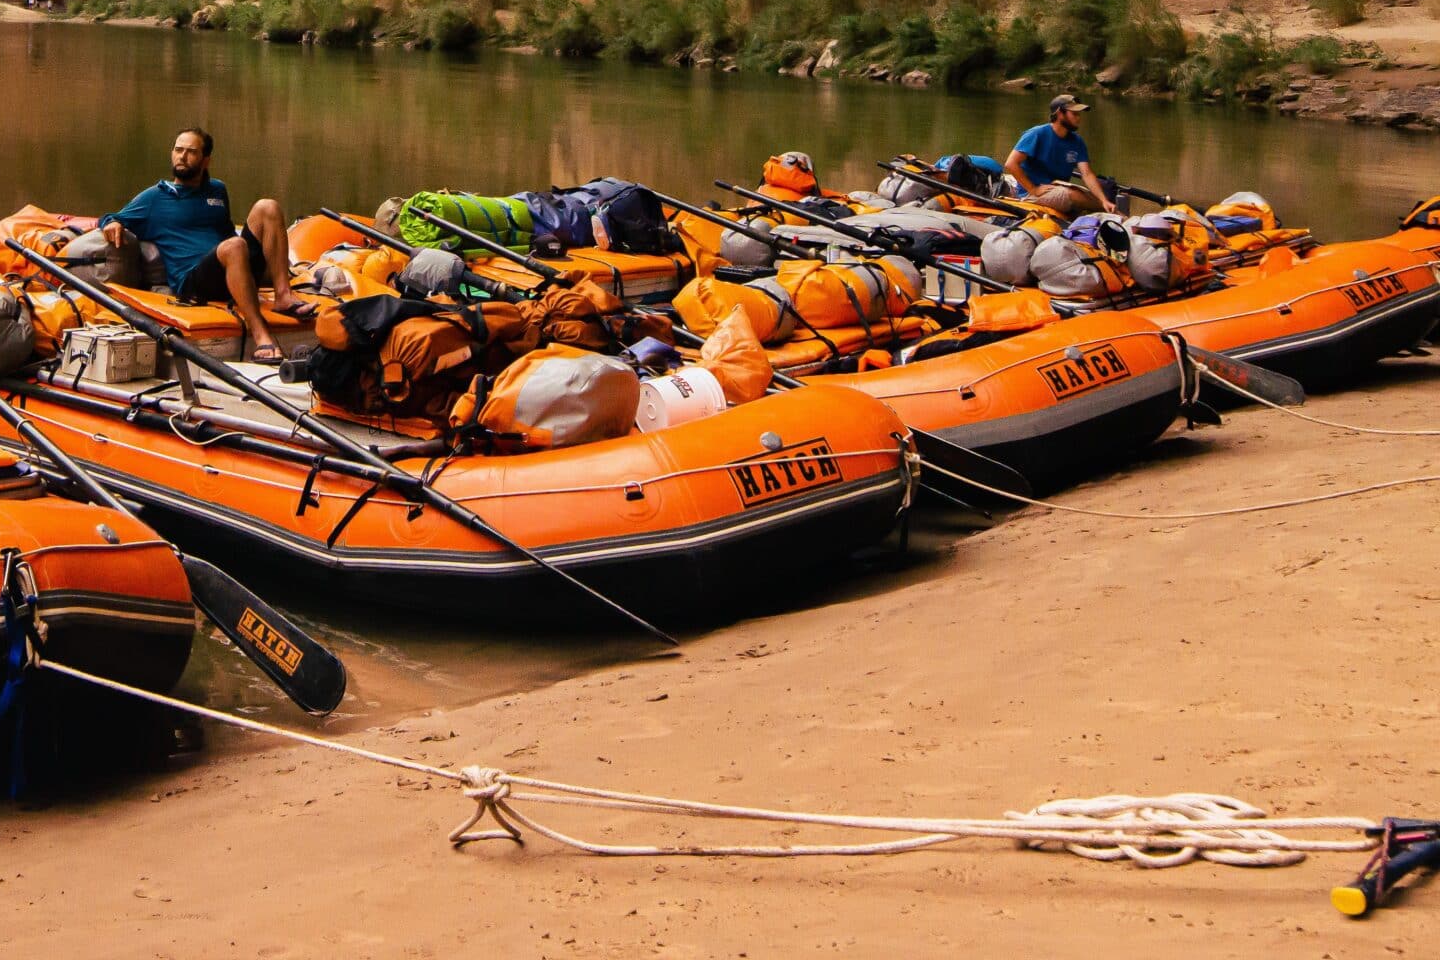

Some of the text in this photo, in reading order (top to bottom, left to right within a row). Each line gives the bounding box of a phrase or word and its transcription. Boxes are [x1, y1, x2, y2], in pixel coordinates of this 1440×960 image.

[1344, 274, 1403, 307] HATCH
[1045, 349, 1126, 393] HATCH
[735, 445, 837, 498] HATCH
[241, 612, 301, 668] HATCH
